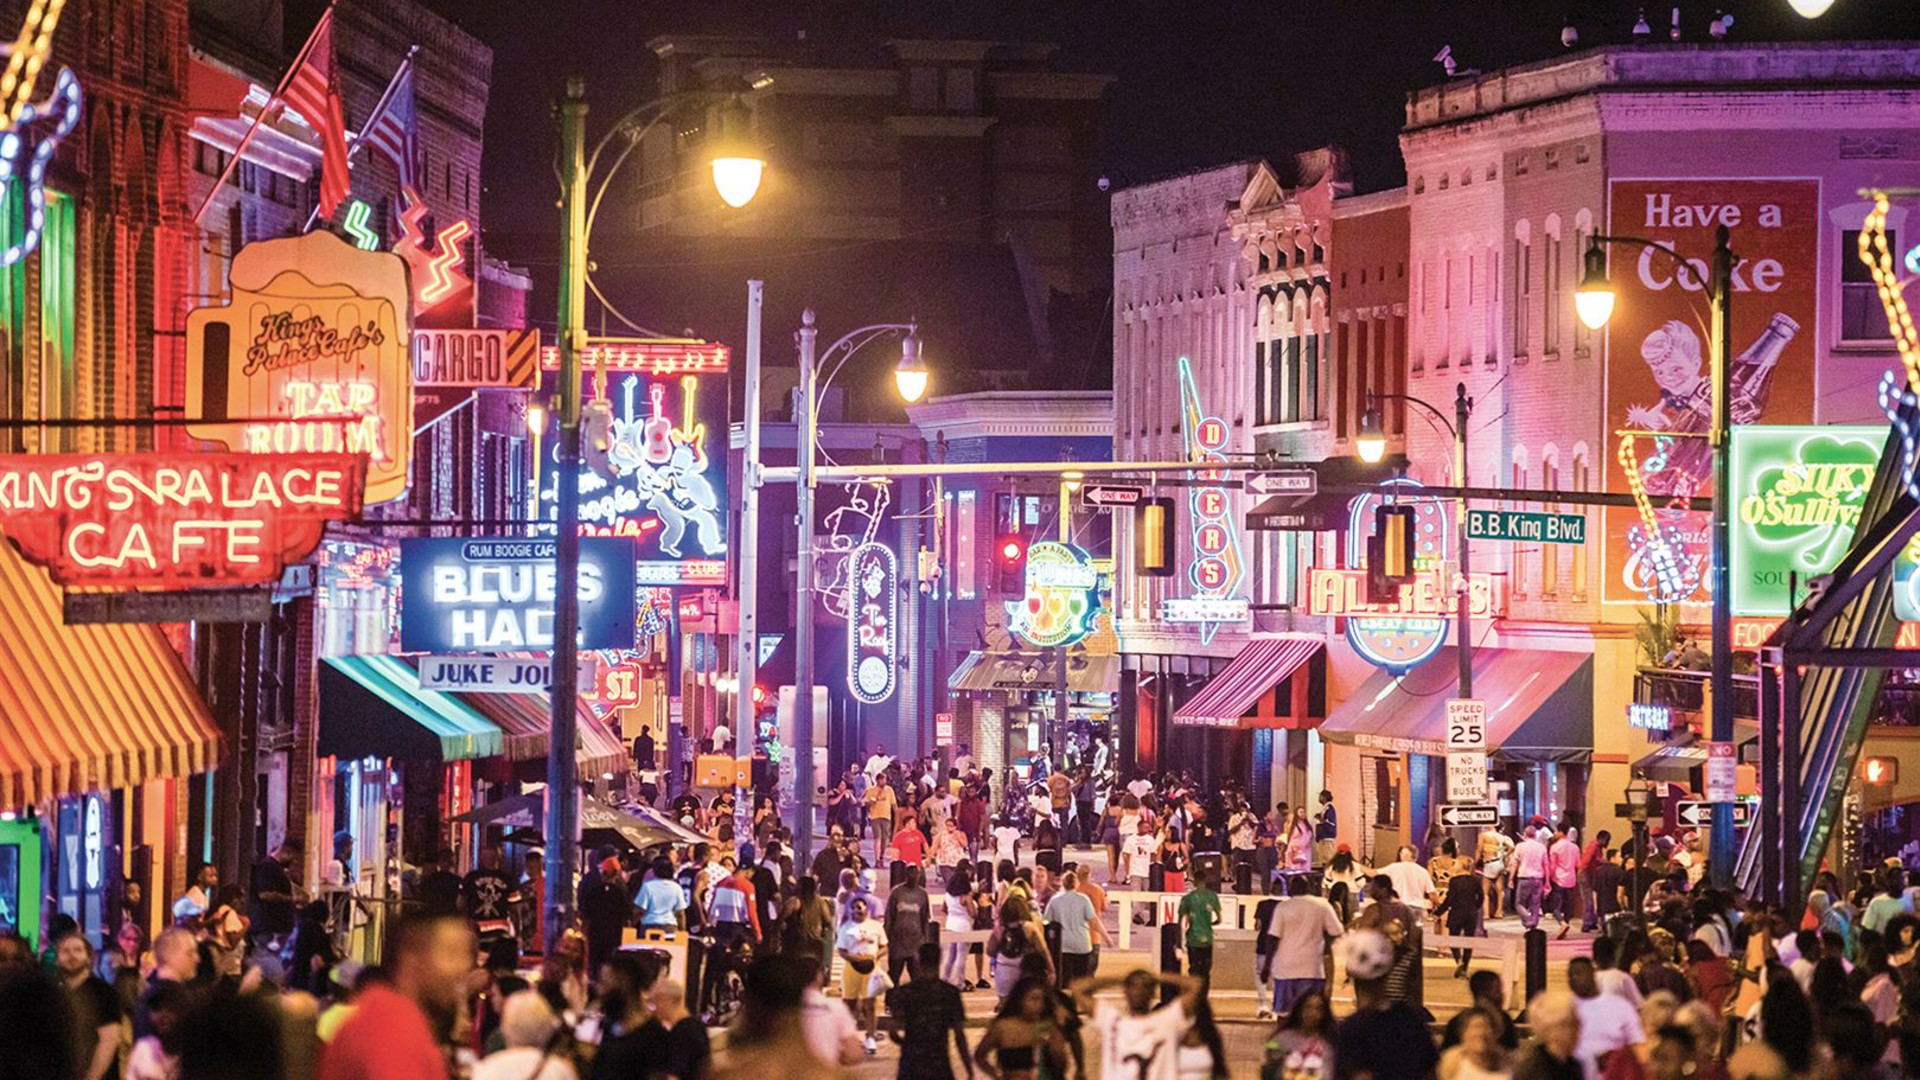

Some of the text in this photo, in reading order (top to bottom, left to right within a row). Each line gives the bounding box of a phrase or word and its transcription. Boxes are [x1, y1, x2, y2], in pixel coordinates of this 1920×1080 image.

[1644, 193, 1782, 228] Have a
[1637, 240, 1784, 292] Coke
[243, 341, 321, 376] Palace
[414, 333, 500, 382] CARGO
[286, 381, 375, 419] TAP
[248, 415, 380, 460] ROOM
[1265, 478, 1309, 488] ONE WAY
[1775, 462, 1877, 498] SILKY
[1119, 492, 1137, 500] WAY
[1202, 423, 1220, 584] DYER'S
[1470, 513, 1583, 540] B.B. King Blvd.
[68, 518, 265, 569] CAFE
[470, 544, 556, 557] RUM BOOGIE CAF
[433, 563, 603, 603] BLUES
[452, 608, 584, 647] HAL
[432, 663, 494, 686] JUKE
[1450, 704, 1483, 713] SPEED
[1453, 715, 1478, 723] LIMIT
[1451, 725, 1482, 743] 25
[1450, 767, 1484, 775] TRUCKS
[1460, 757, 1473, 765] NO
[1453, 788, 1482, 796] BUSES
[1457, 812, 1492, 820] ONE WAY
[1699, 810, 1713, 818] ON
